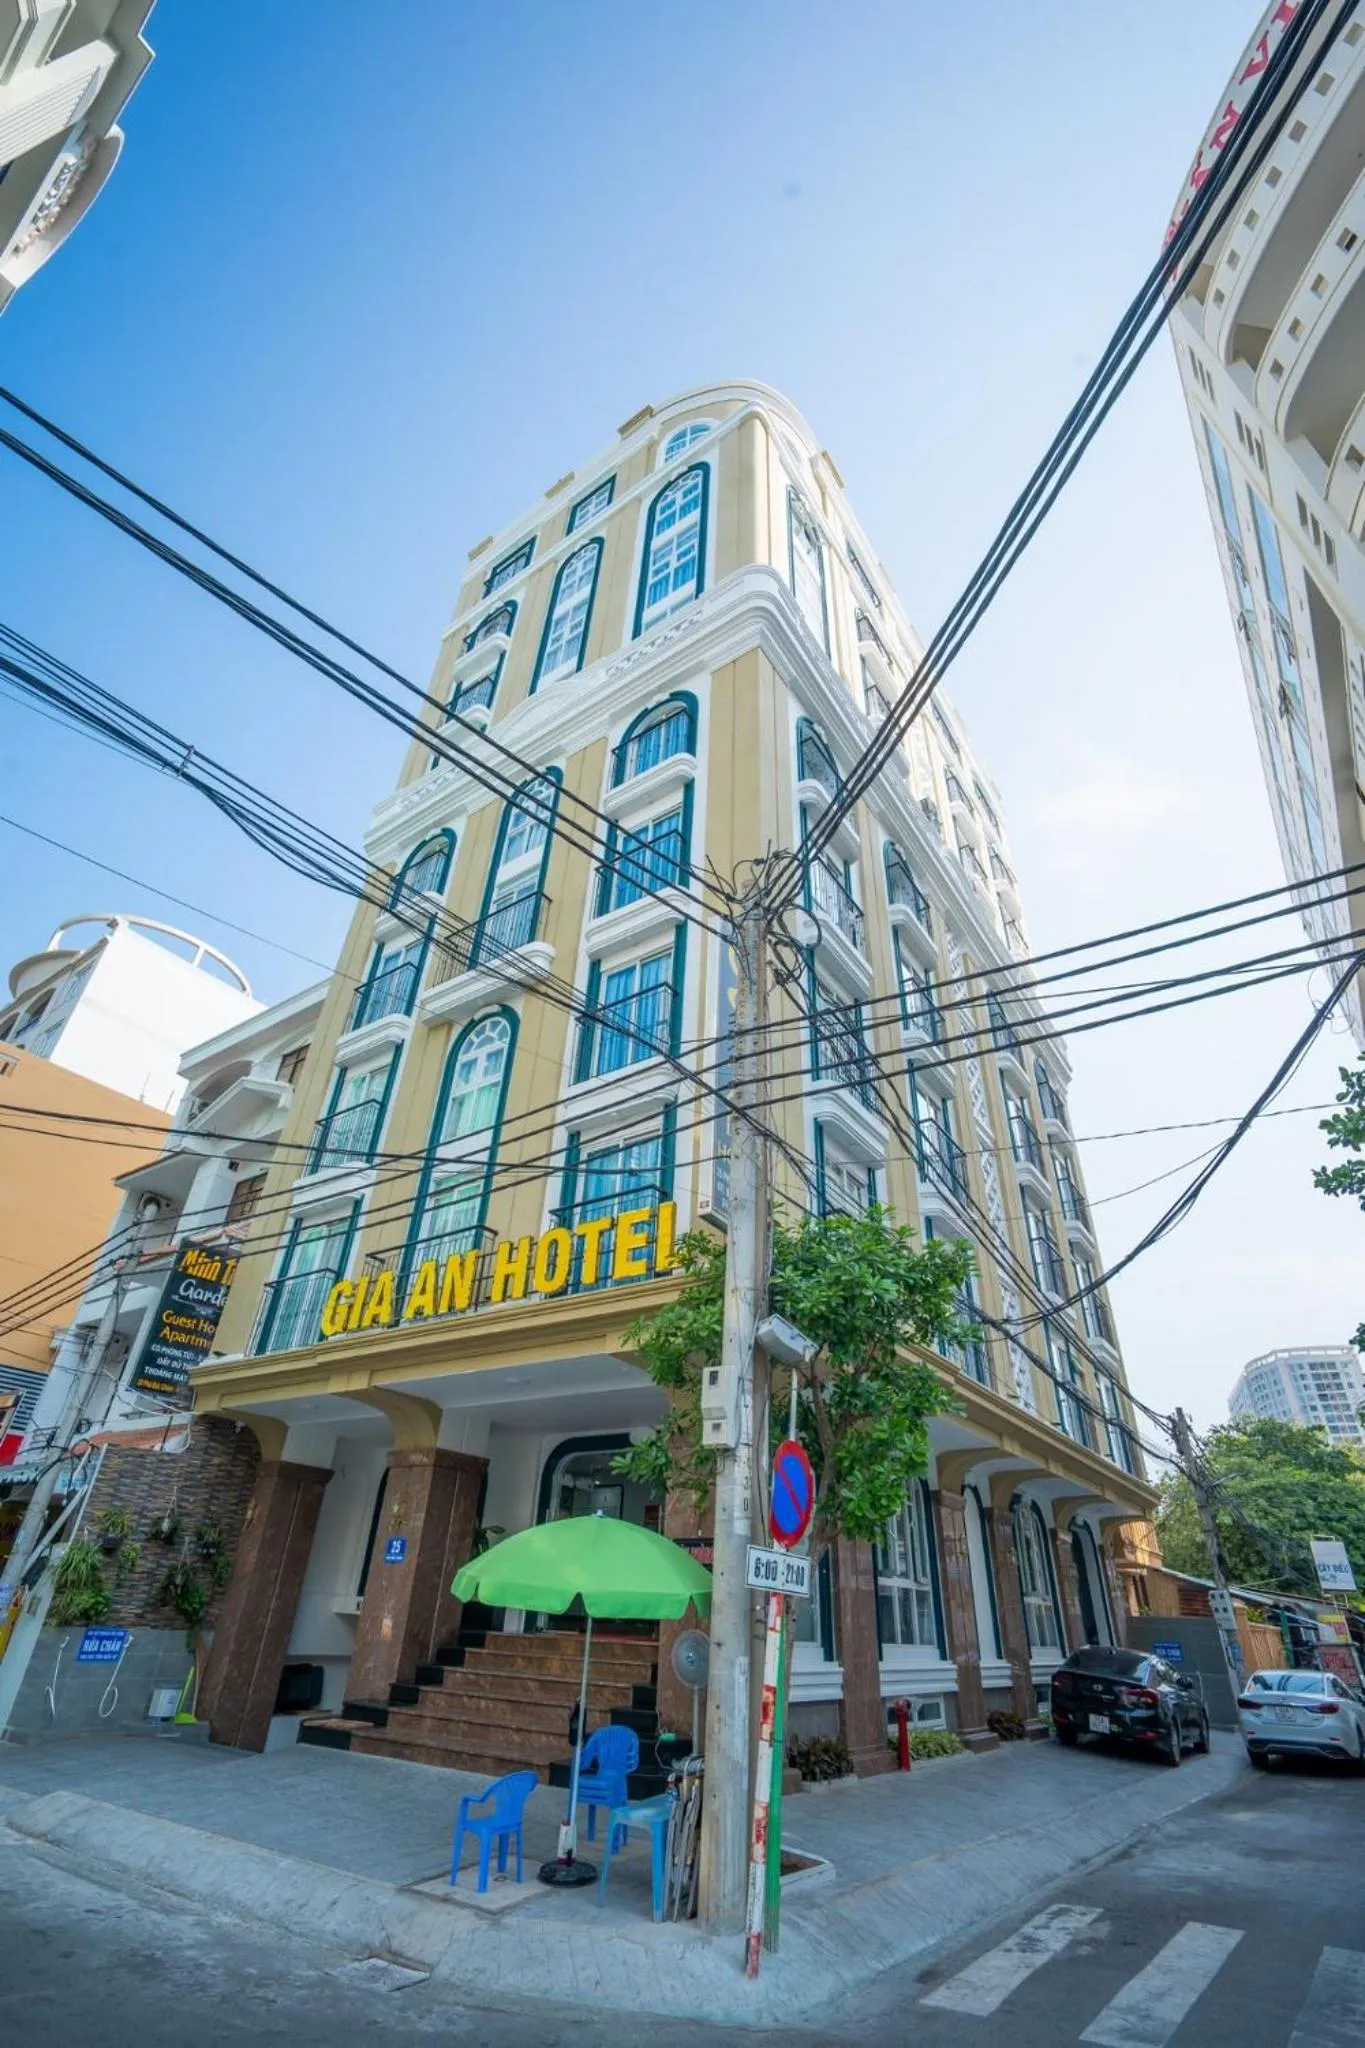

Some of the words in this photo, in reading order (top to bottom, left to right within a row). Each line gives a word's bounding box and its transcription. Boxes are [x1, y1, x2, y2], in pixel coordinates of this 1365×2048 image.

[320, 1270, 395, 1337] GIA
[402, 1248, 479, 1321] AN
[490, 1201, 683, 1305] HOTEL
[163, 1310, 199, 1329] Guest
[160, 1325, 211, 1349] Apartm
[754, 1557, 779, 1582] 6:00
[785, 1563, 805, 1587] 21:00
